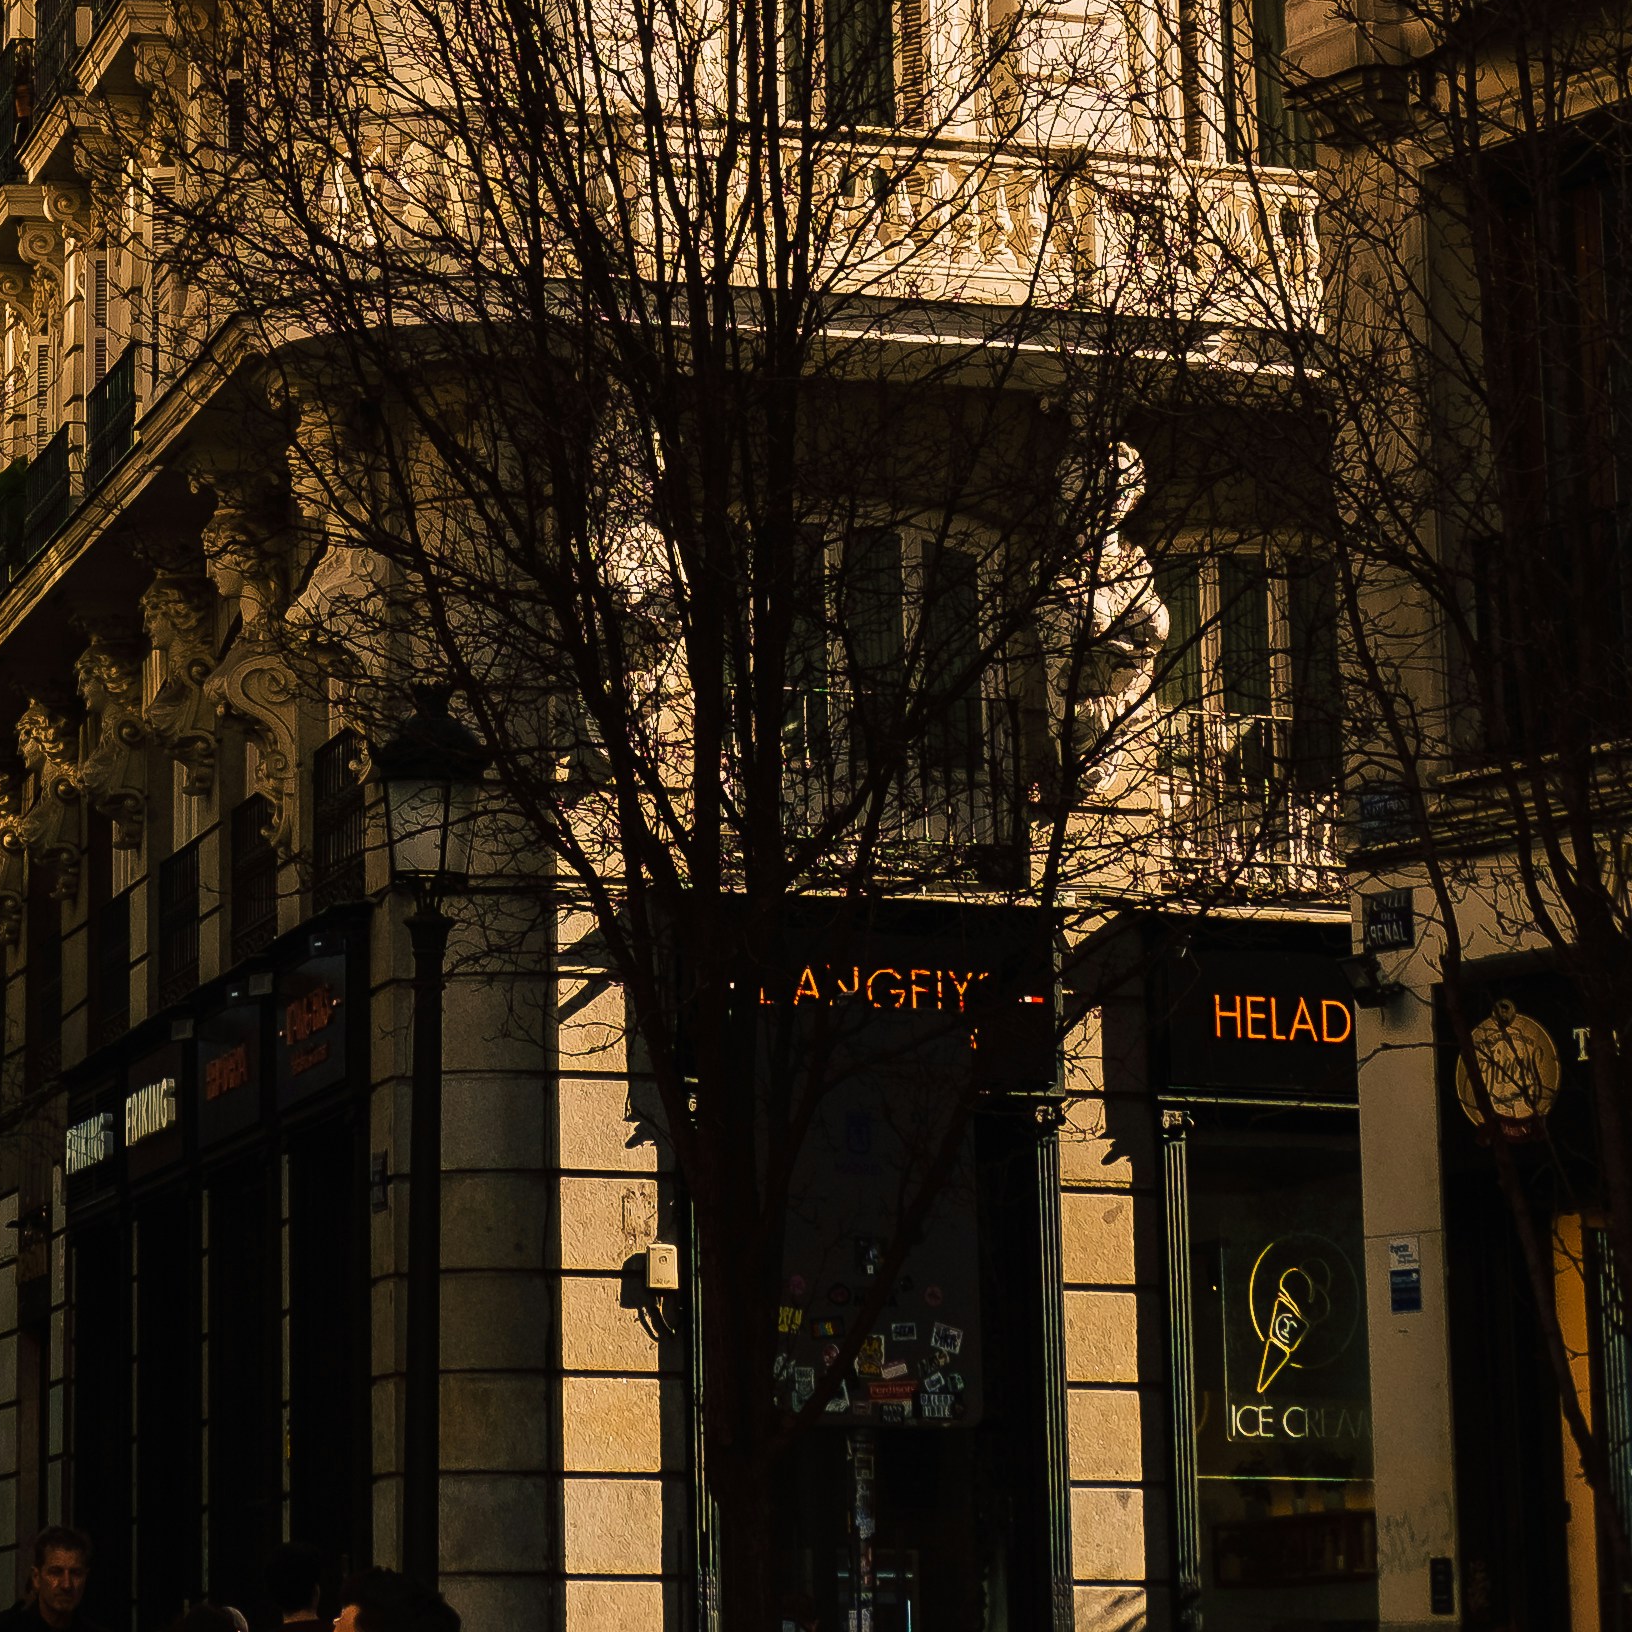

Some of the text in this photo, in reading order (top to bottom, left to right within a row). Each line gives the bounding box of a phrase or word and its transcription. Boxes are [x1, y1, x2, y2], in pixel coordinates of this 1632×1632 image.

[1213, 994, 1352, 1043] HELAD
[126, 1078, 169, 1147] FRIKING
[66, 1112, 106, 1176] FRIKING
[1231, 1404, 1275, 1438] ICE
